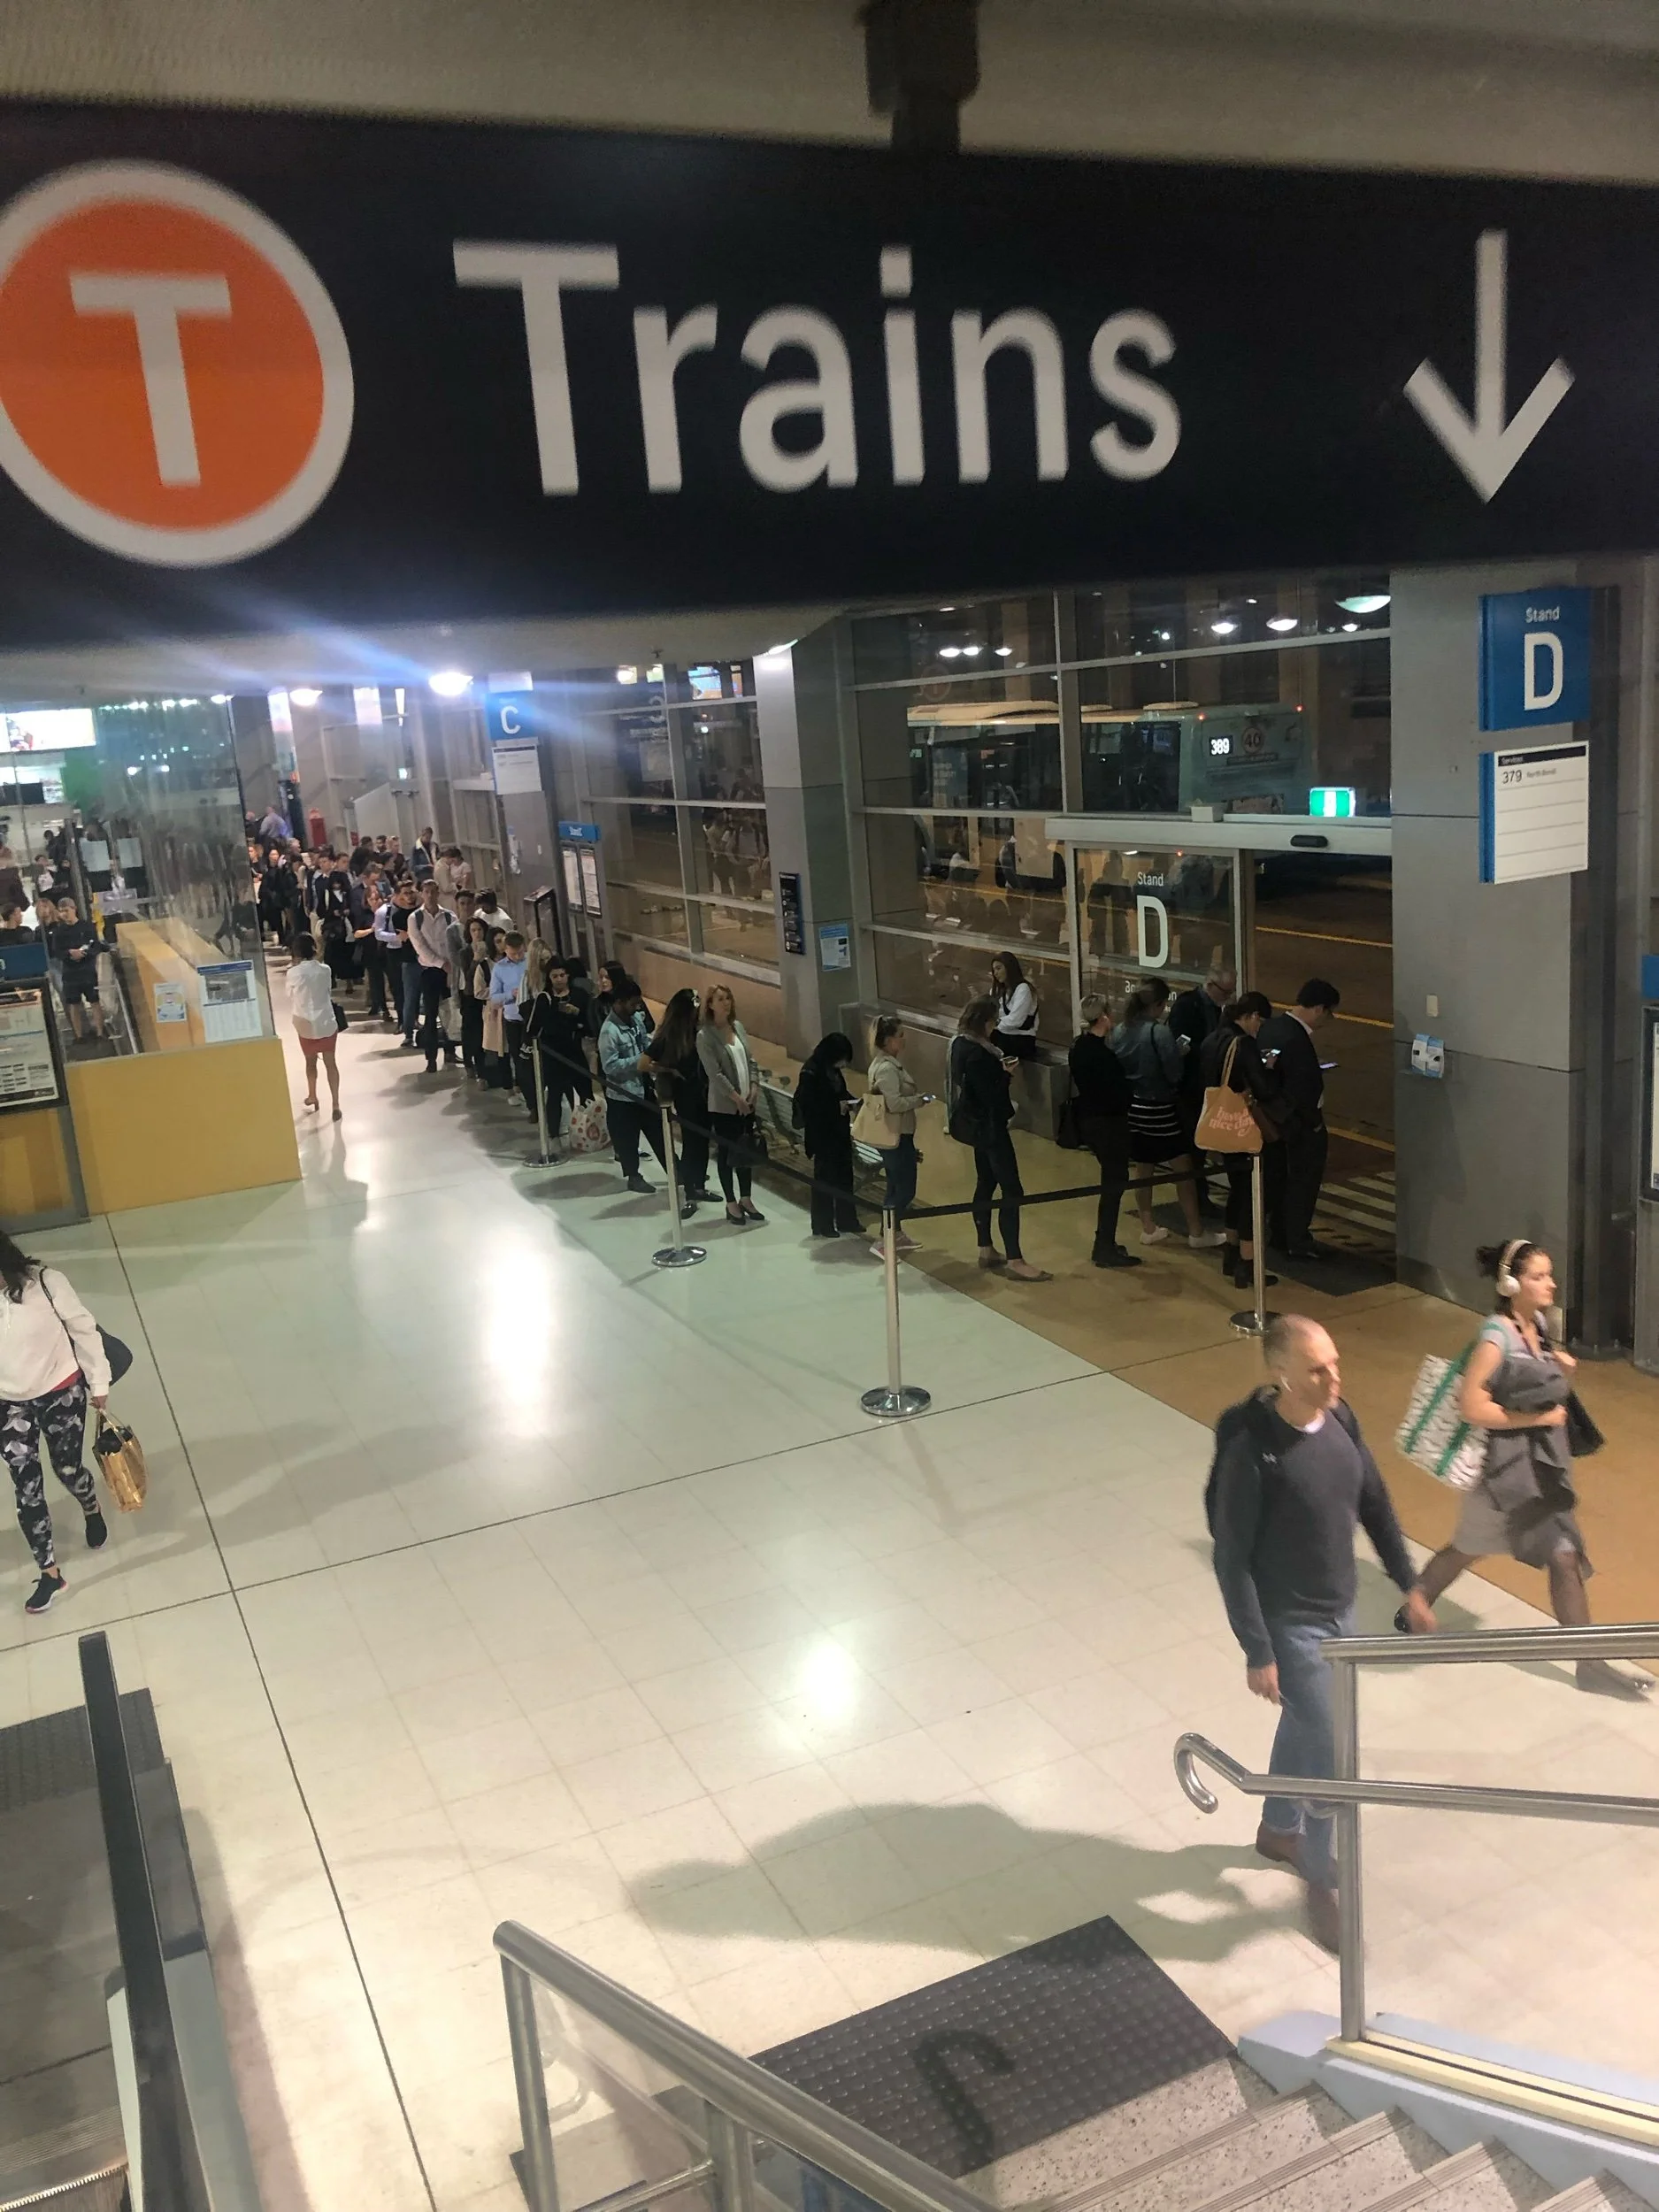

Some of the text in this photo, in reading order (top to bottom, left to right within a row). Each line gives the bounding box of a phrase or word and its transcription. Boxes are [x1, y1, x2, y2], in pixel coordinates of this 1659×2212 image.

[67, 273, 234, 488] T
[452, 242, 1180, 495] Trains
[1526, 607, 1560, 623] Stand
[1524, 632, 1563, 710] D
[501, 705, 520, 733] C
[1211, 738, 1230, 755] 389
[1502, 770, 1522, 784] 379
[1137, 871, 1164, 887] Stand
[1136, 895, 1169, 969] D
